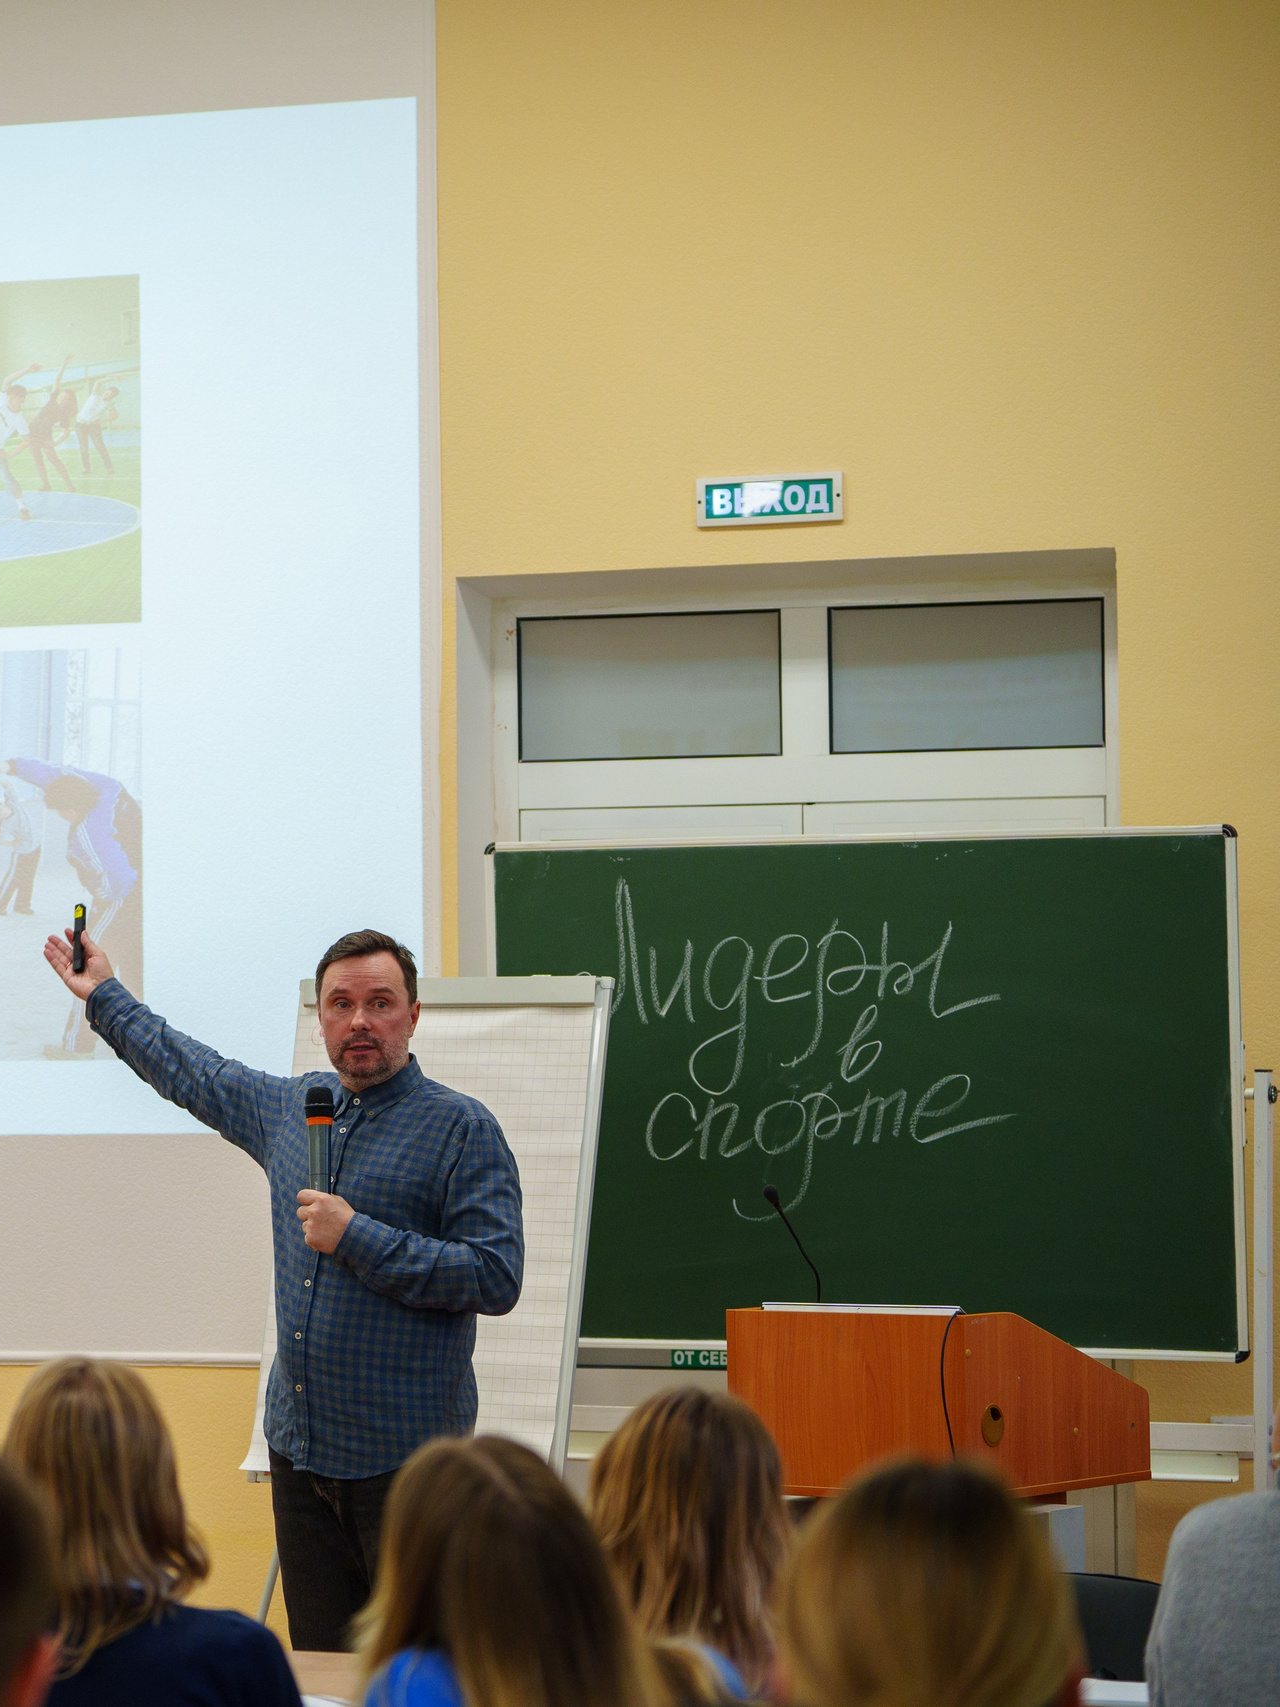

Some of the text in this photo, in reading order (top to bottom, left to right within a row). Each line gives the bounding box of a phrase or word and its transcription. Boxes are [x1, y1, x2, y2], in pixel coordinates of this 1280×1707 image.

[612, 875, 1002, 1095] Лидеры
[836, 1004, 883, 1083] в
[644, 1073, 1020, 1221] спорте
[673, 1350, 727, 1366] ОТ СЕБ
